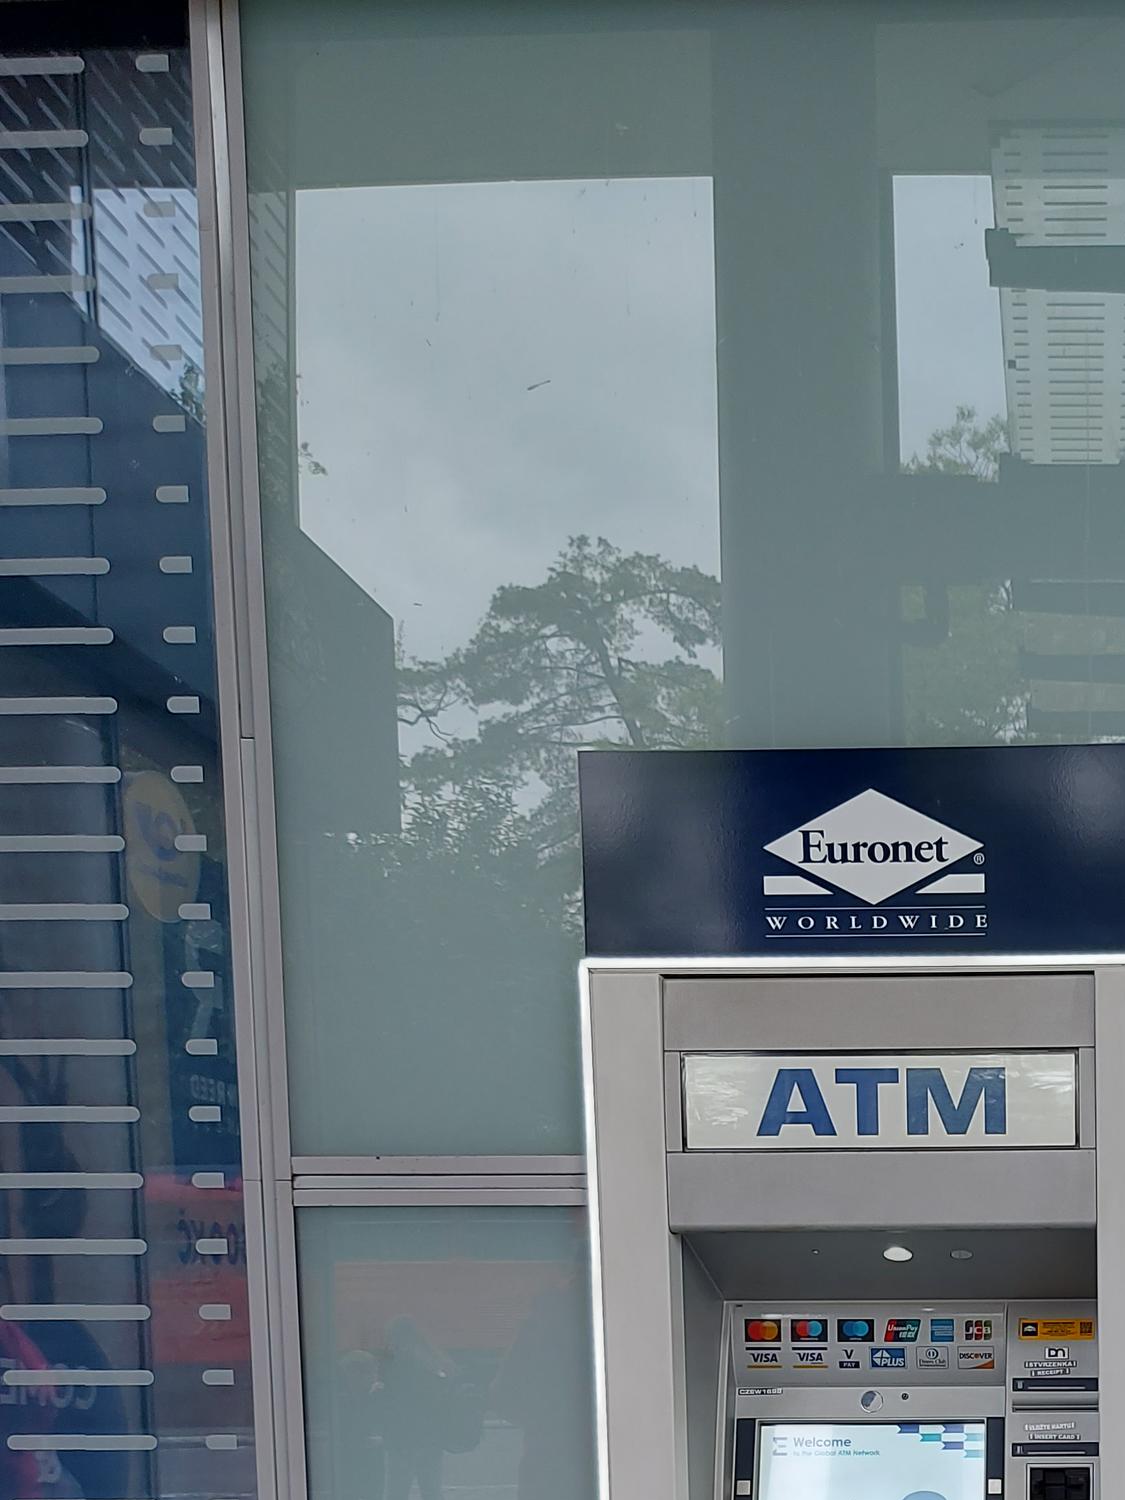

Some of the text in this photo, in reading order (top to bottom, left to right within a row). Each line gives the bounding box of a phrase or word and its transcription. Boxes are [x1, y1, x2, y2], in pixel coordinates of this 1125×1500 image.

[798, 830, 950, 864] Euronet
[765, 914, 988, 930] WORLDWIDE
[756, 1066, 1007, 1137] ATM
[965, 1326, 991, 1335] JCB
[750, 1353, 778, 1363] VISA
[796, 1352, 823, 1362] VISA
[959, 1352, 993, 1360] DISCOVER
[881, 1358, 905, 1367] PLUS
[793, 1437, 852, 1448] Welcome
